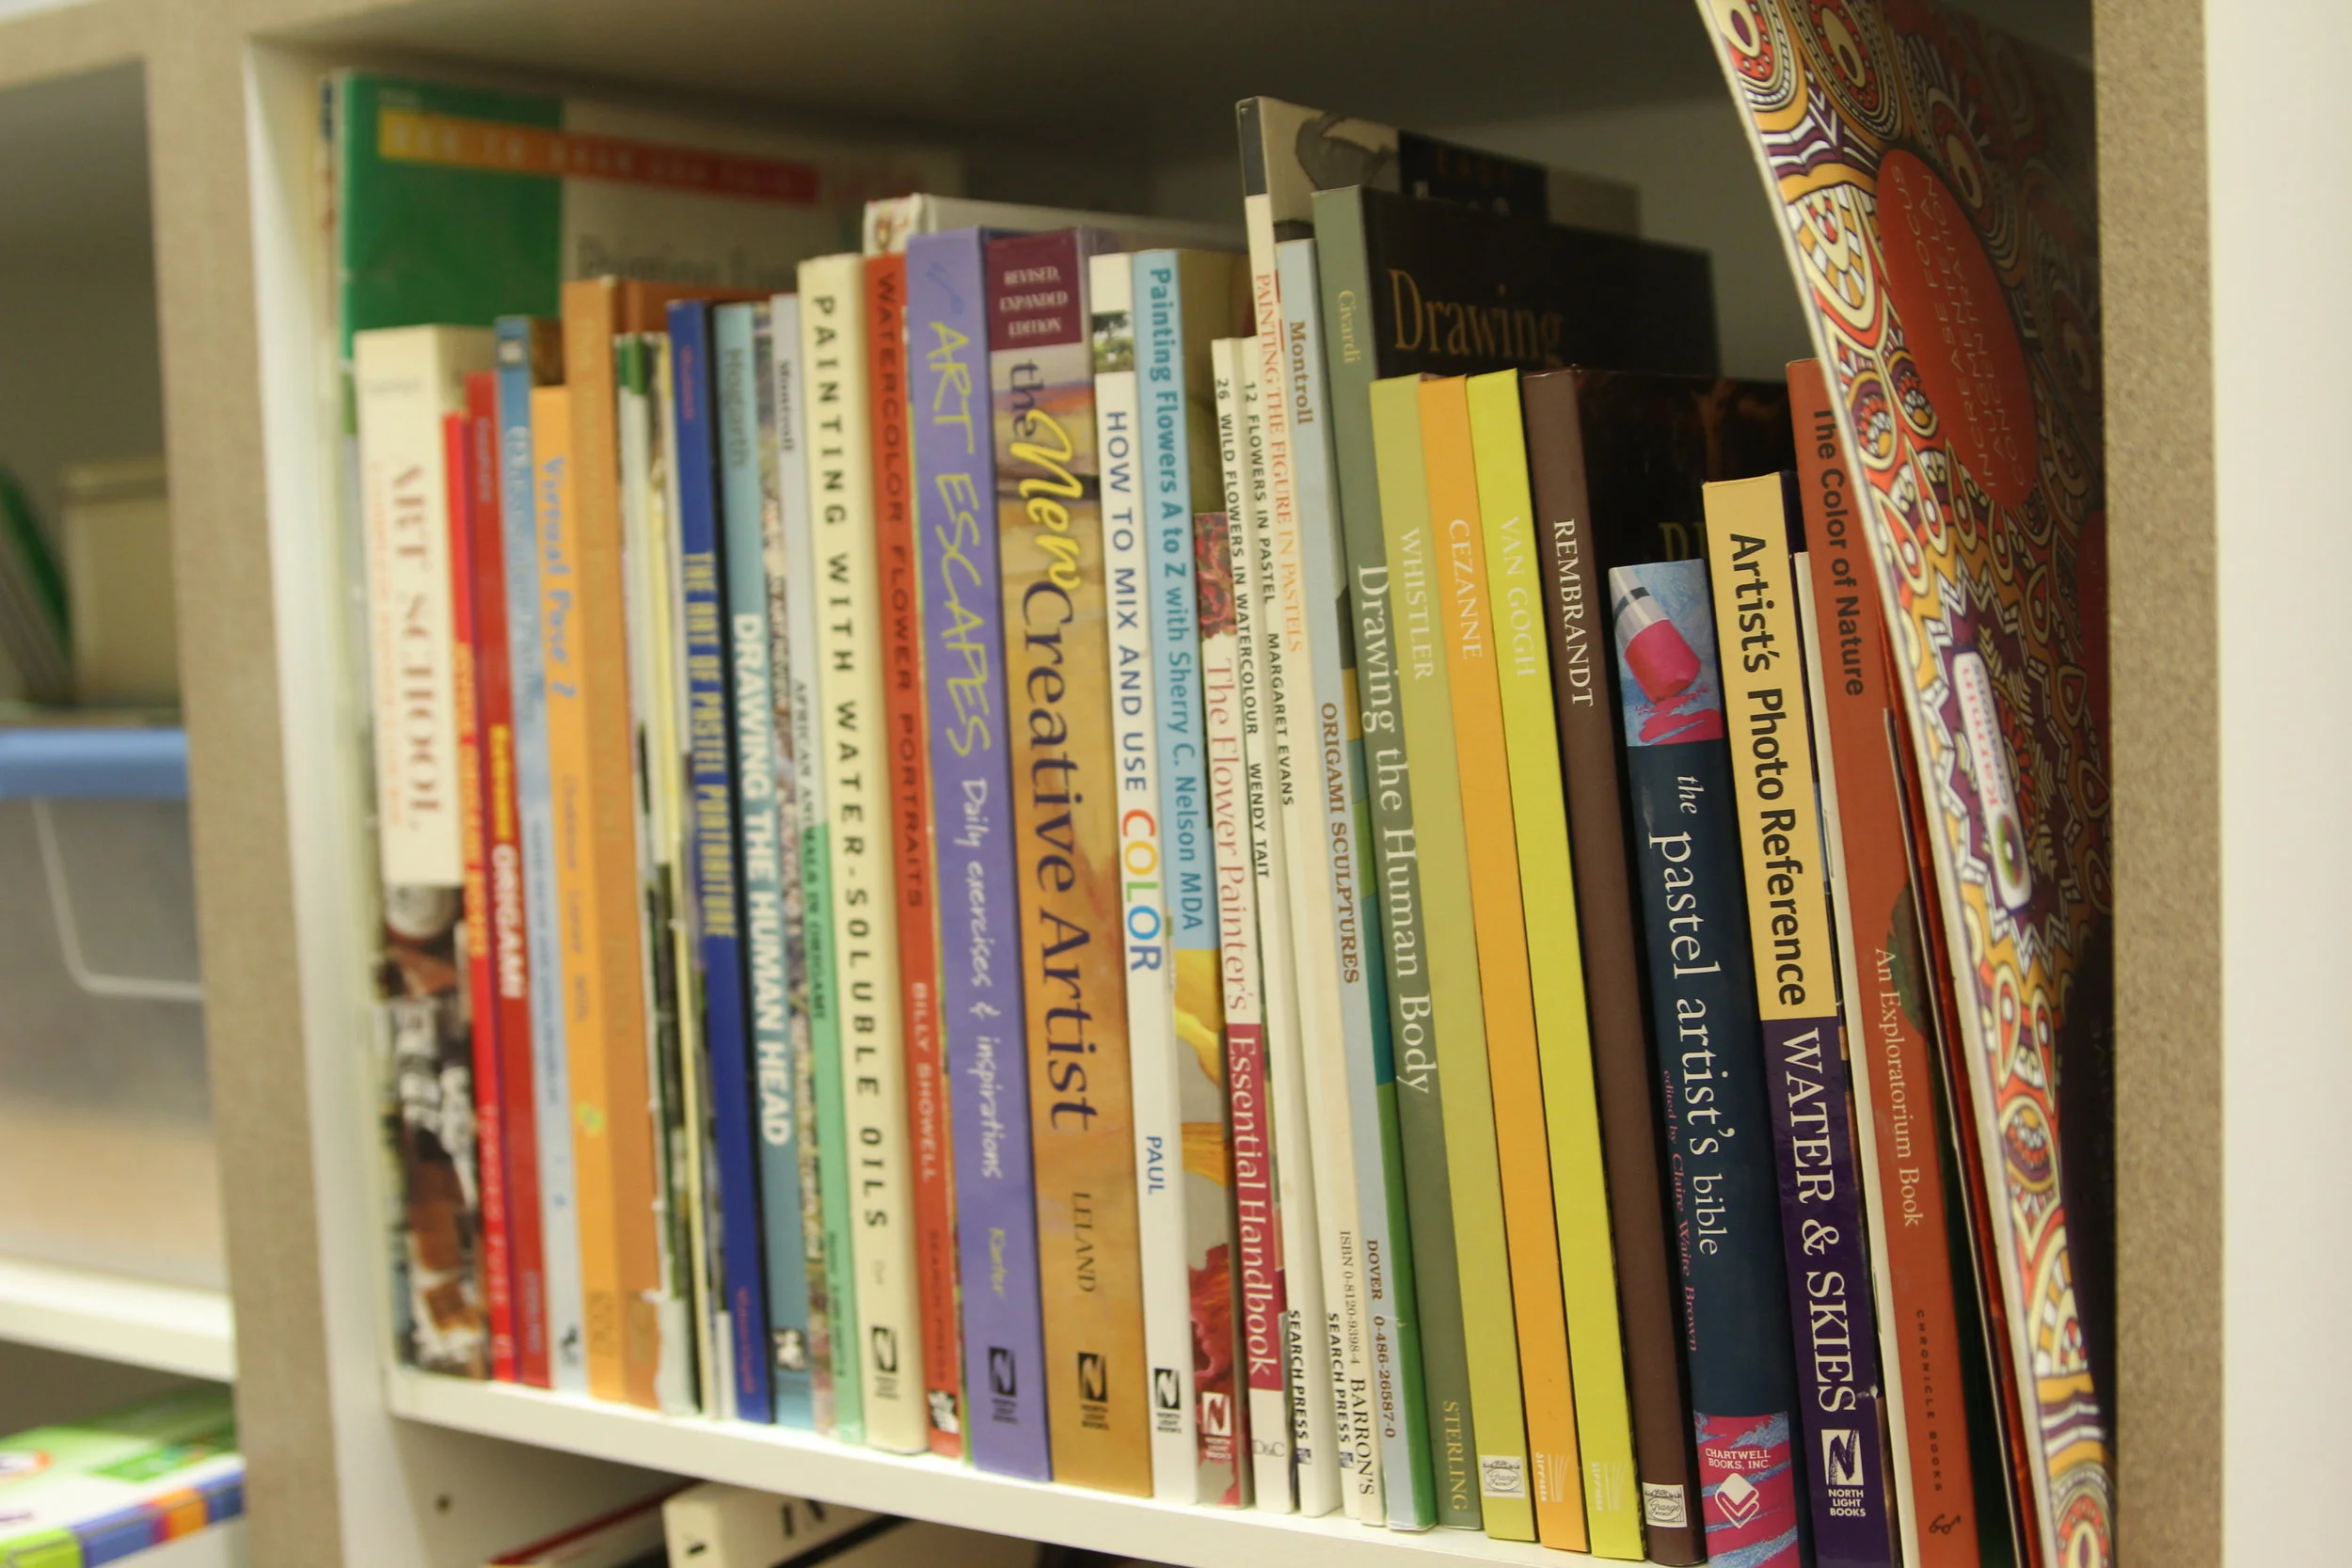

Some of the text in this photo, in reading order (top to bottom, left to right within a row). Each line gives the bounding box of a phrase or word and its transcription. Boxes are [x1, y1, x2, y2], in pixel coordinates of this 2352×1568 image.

[999, 289, 1068, 311] EXPANDED
[1008, 315, 1062, 339] EDITION
[1288, 321, 1313, 425] Montroll
[1338, 289, 1361, 365] Civardi
[1387, 268, 1565, 368] Drawing
[813, 294, 848, 525] PAINTING
[1255, 273, 1303, 653] PAINTING THE FIGURE IN PASTELS
[543, 456, 572, 576] Virtual
[926, 321, 991, 756] ART ESCAPES
[1820, 467, 1848, 548] Color
[1832, 557, 1858, 587] of
[548, 588, 578, 671] Pose
[826, 553, 853, 673] WITH
[876, 273, 923, 910] WATERCOLOR FLOWER PORTRAITS
[1149, 267, 1203, 930] Painting Flowers A to Z with Sherry C. Nelson MDA
[1216, 378, 1270, 879] 26 WILD FLOWERS IN WATERCOLOUR WENDY TAIT
[1244, 382, 1295, 807] 12 FLOWERS IN PASTEL MARGARET EVANS
[1401, 528, 1435, 680] WHISTLER
[1448, 519, 1483, 659] CEZANNE
[1500, 515, 1537, 677] VAN GOGH
[1553, 518, 1594, 707] REMBRANDT
[1836, 595, 1865, 697] Nature
[691, 691, 727, 772] PASTEL
[793, 680, 811, 778] AFRICAN
[1009, 357, 1098, 1132] the New Creative Artist
[1105, 410, 1162, 971] HOW TO MIX AND USE COLOR
[953, 777, 988, 851] Daily
[1207, 657, 1254, 1011] The Flower Painter's
[1359, 564, 1438, 1094] Drawing the Human Body
[1729, 532, 1807, 1006] Artist's Photo Reference
[733, 613, 793, 1147] DRAWING THE HUMAN HEAD
[834, 702, 881, 1097] WATER-SOLUBLE
[1321, 702, 1359, 985] ORIGAMI SCULPTURES
[962, 860, 993, 989] exercises
[911, 982, 937, 1183] BILLY SHOWELL
[1647, 774, 1735, 1257] the pastel artist's bible
[1875, 948, 1922, 1227] An Exploratorium Book
[859, 1128, 887, 1228] OILS
[967, 1034, 1003, 1180] inspirations
[1147, 1135, 1166, 1196] PAUL
[1072, 1191, 1096, 1292] LELAND
[1229, 1036, 1279, 1377] Essential Handbook
[1662, 1069, 1697, 1352] edited by Claire Waite Brown
[1783, 1027, 1857, 1413] WATER & SKIES
[1289, 1309, 1309, 1440] SEARCH PRESS
[1328, 1313, 1351, 1443] SEARCH PRESS
[1340, 1230, 1355, 1267] ISBN
[1350, 1378, 1375, 1496] BARRON'S
[1367, 1239, 1396, 1439] DOVER 0-486-26587-0
[1916, 1308, 1944, 1493] CHRONICLE BOOKS
[1443, 1400, 1468, 1512] STERLING
[1705, 1447, 1771, 1460] CHARTWELL
[1708, 1459, 1771, 1471] BOOKS, INC.
[1828, 1489, 1865, 1498] NORTH
[1829, 1508, 1867, 1517] BOOKS
[1832, 1498, 1862, 1508] LIGHT
